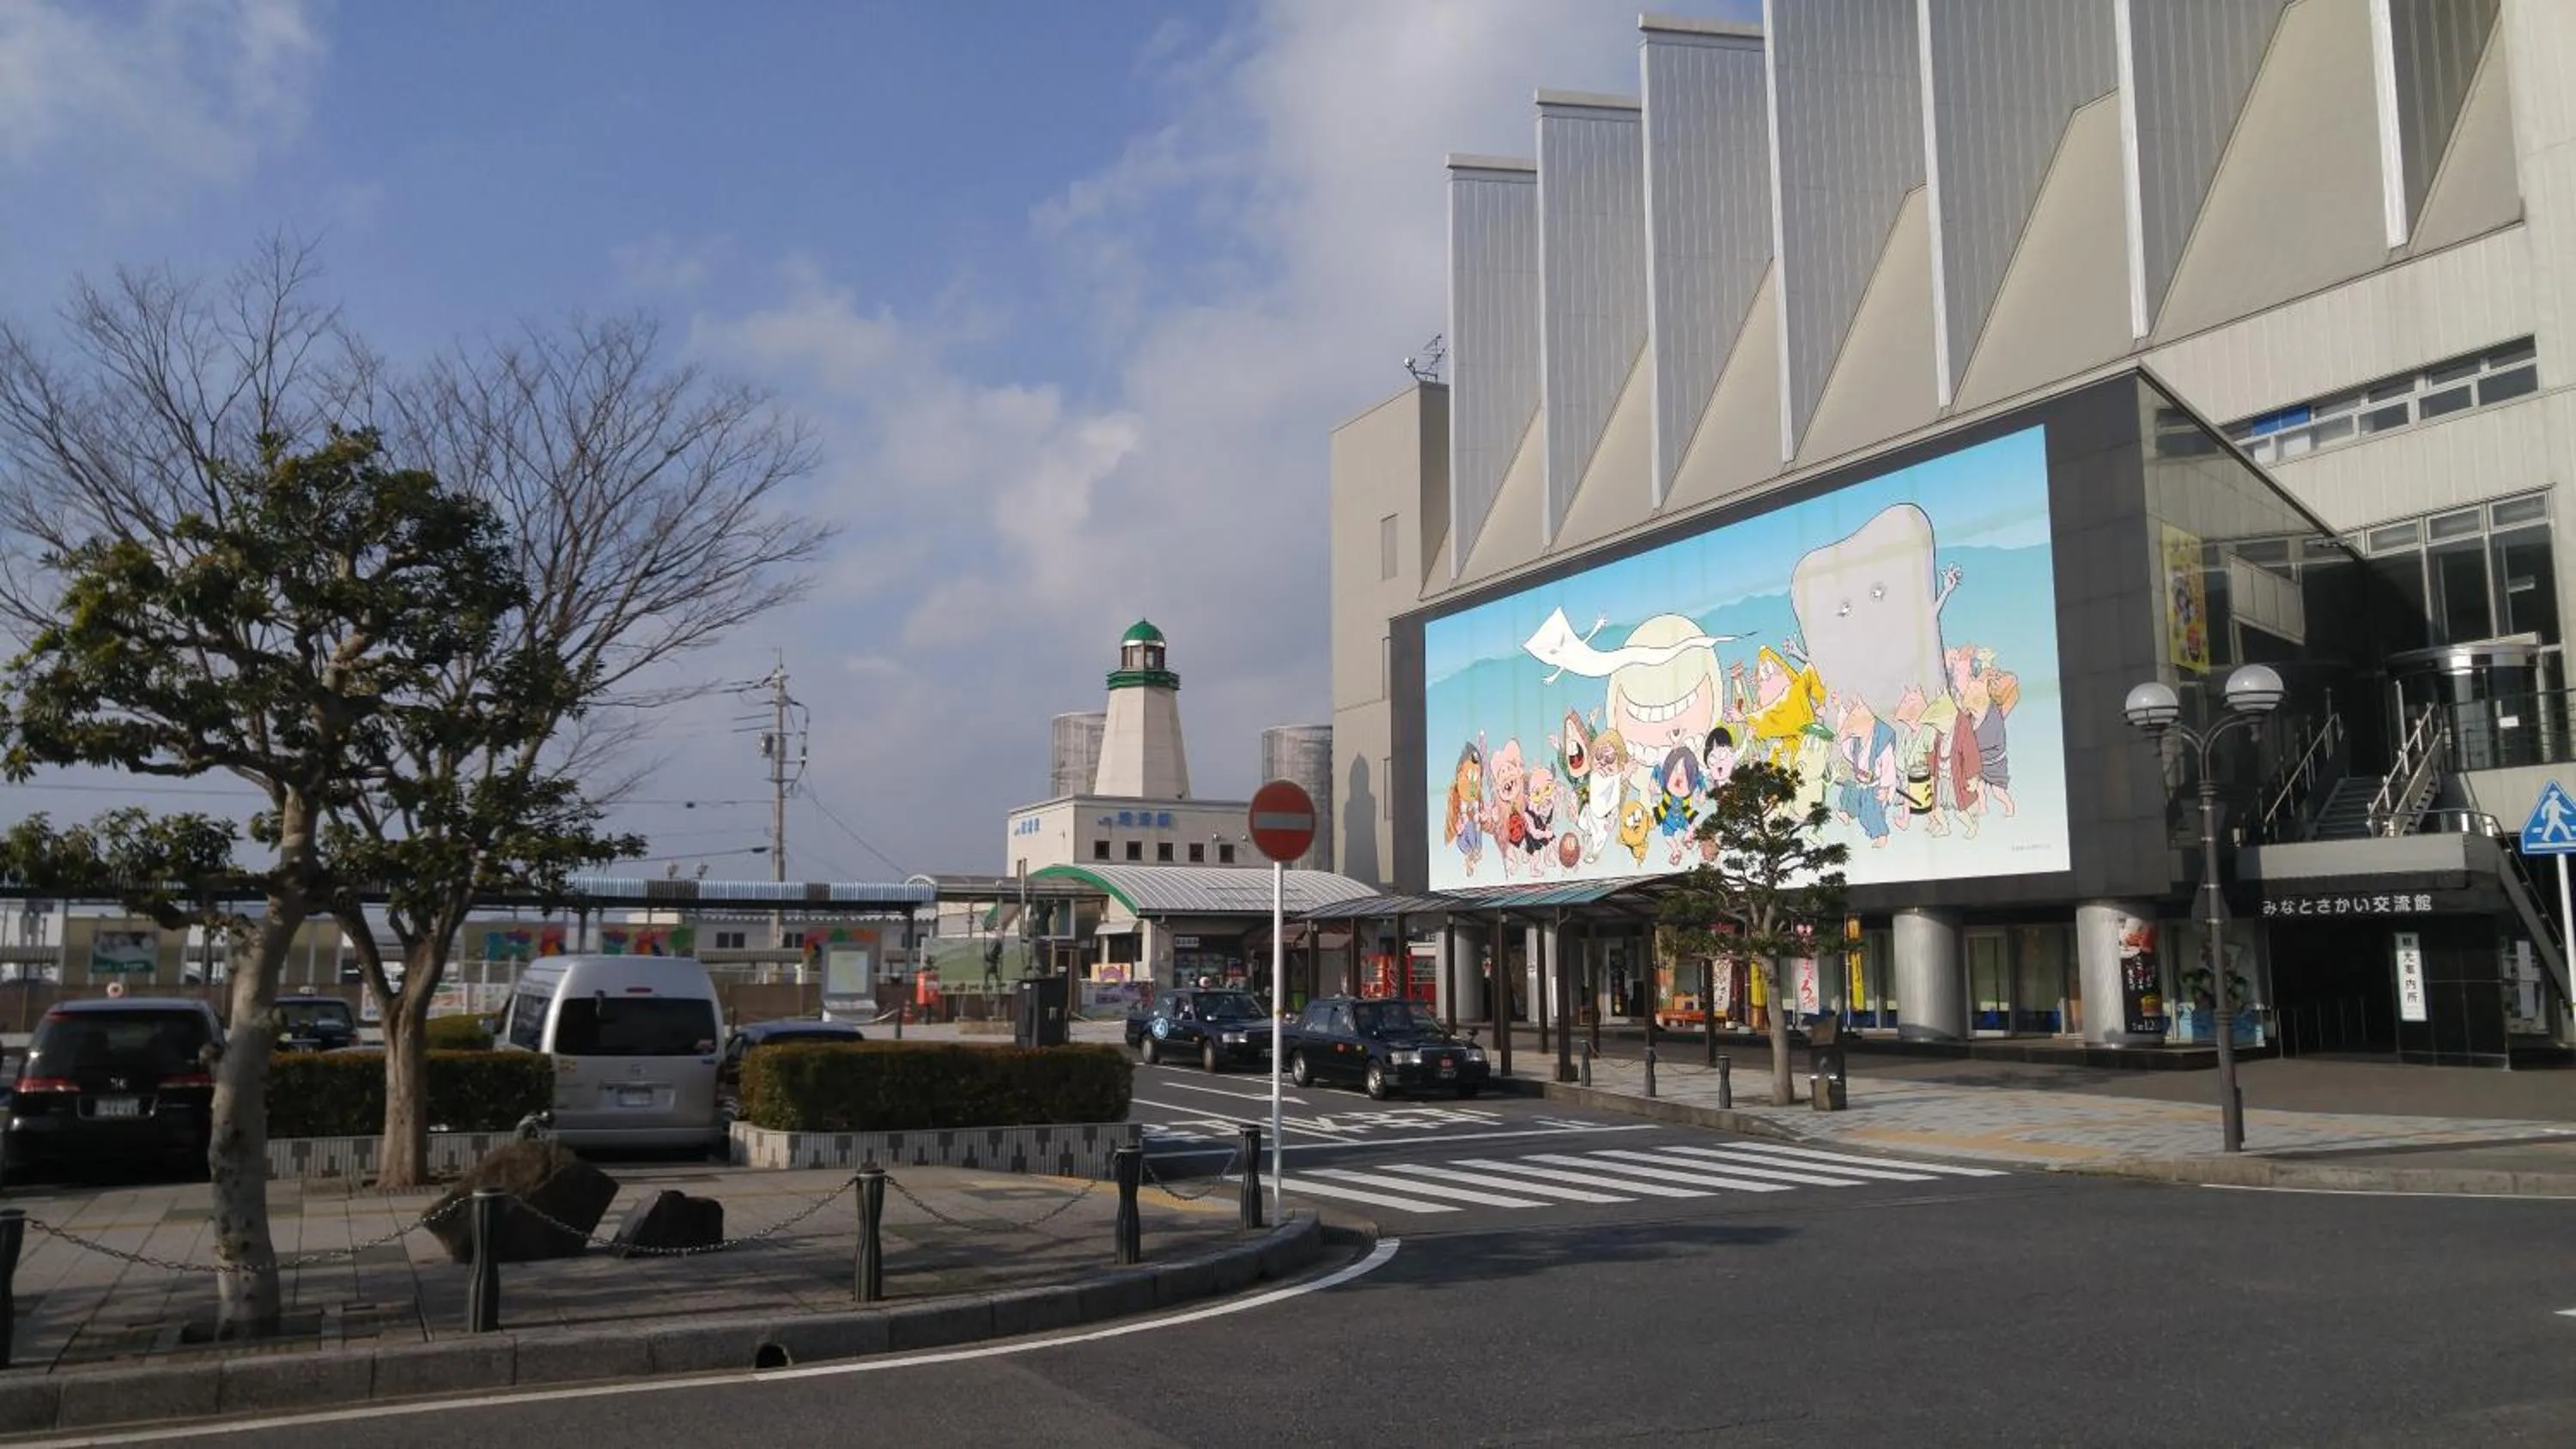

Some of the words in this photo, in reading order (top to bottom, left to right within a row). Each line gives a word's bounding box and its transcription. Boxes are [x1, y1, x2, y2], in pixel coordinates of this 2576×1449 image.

[2262, 894, 2433, 916] みなとさかい交流館
